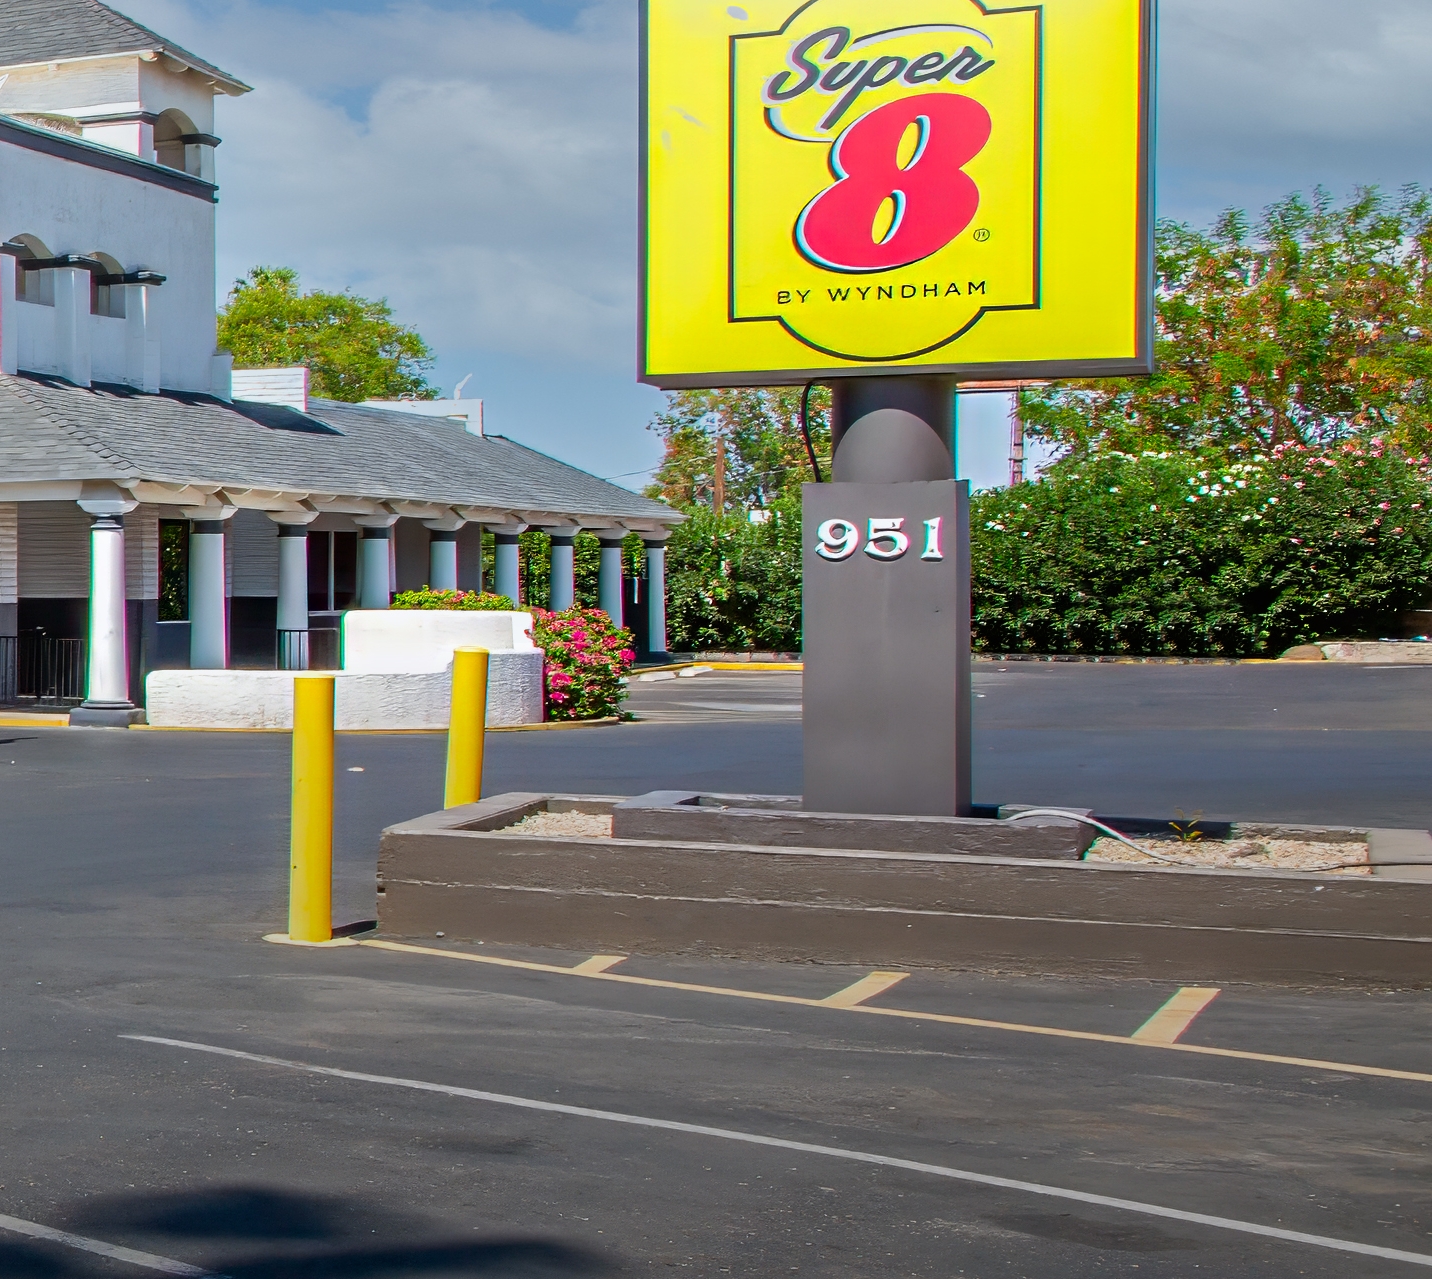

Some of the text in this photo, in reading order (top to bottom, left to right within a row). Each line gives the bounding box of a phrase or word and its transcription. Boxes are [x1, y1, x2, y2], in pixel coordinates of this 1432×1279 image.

[762, 25, 995, 131] Super
[793, 92, 992, 274] 8
[777, 280, 987, 304] BY WYNDHAM
[814, 517, 944, 562] 951
